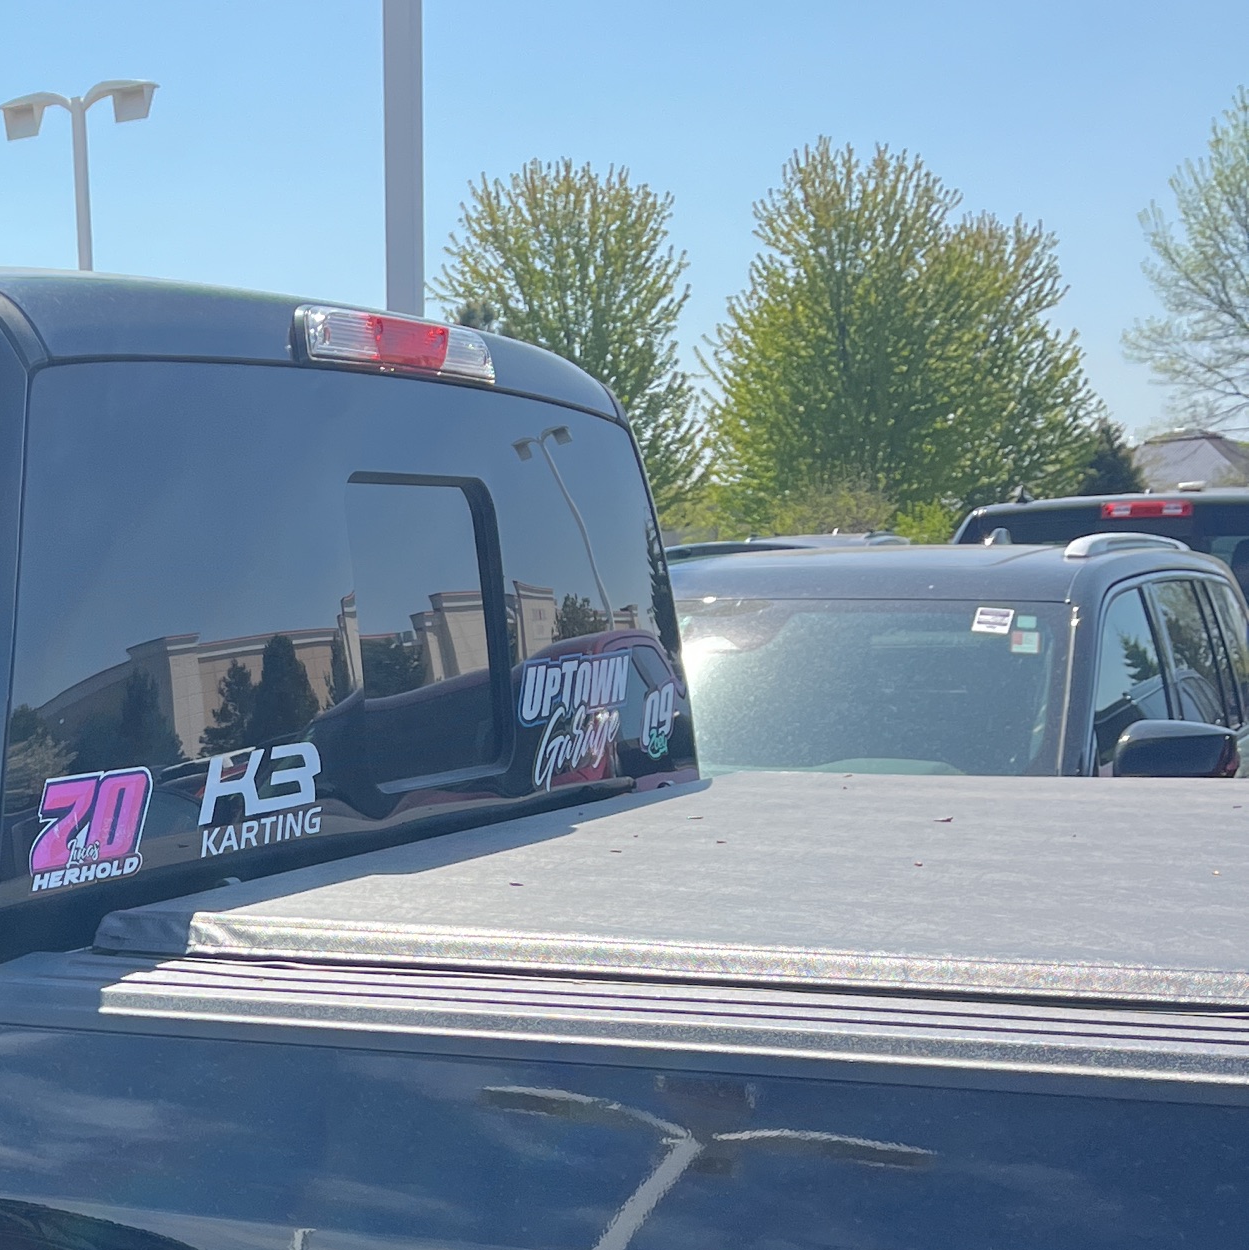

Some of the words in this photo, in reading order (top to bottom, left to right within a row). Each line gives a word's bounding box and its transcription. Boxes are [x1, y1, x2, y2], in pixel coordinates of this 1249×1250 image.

[521, 654, 630, 721] UPTOWN
[30, 766, 153, 876] 70
[201, 806, 322, 858] KARTING
[31, 856, 140, 892] HERHOLD
